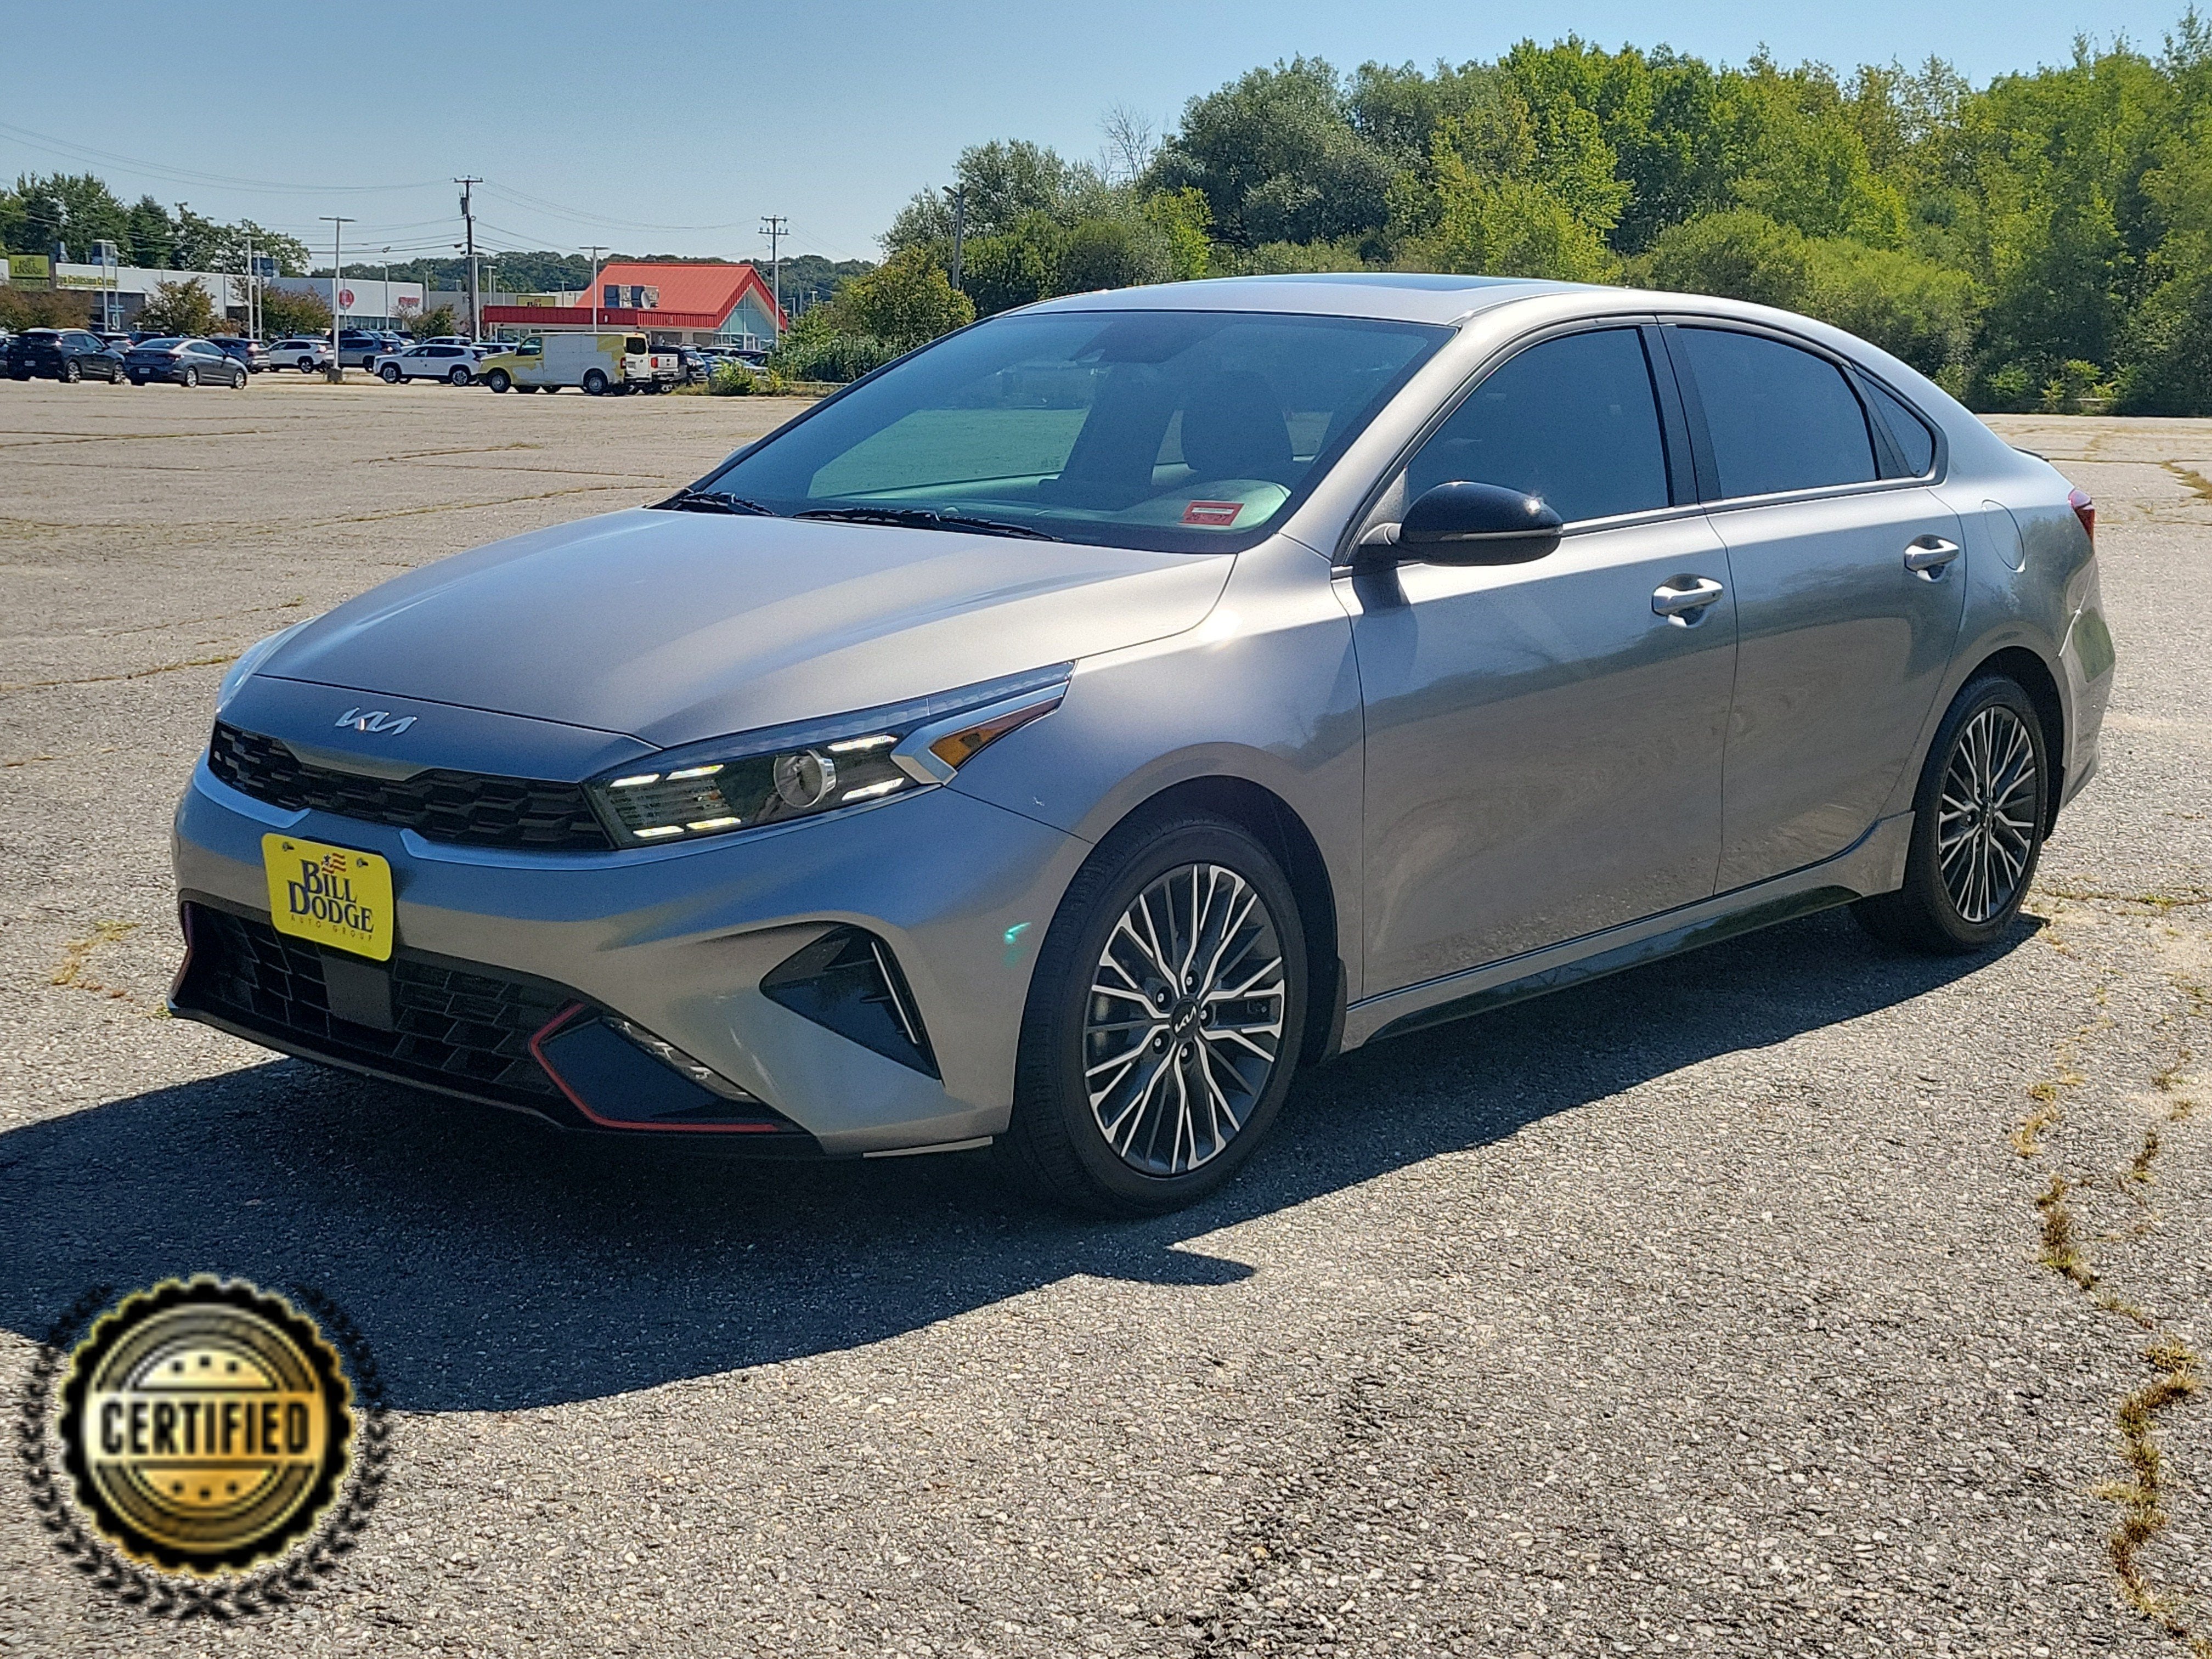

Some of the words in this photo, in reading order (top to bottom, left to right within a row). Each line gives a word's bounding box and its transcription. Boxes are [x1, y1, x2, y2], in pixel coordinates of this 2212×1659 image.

[335, 707, 417, 735] KIA
[300, 859, 357, 903] BILL
[287, 879, 374, 933] DODGE
[291, 914, 321, 928] AUTO
[332, 925, 373, 941] GROUP
